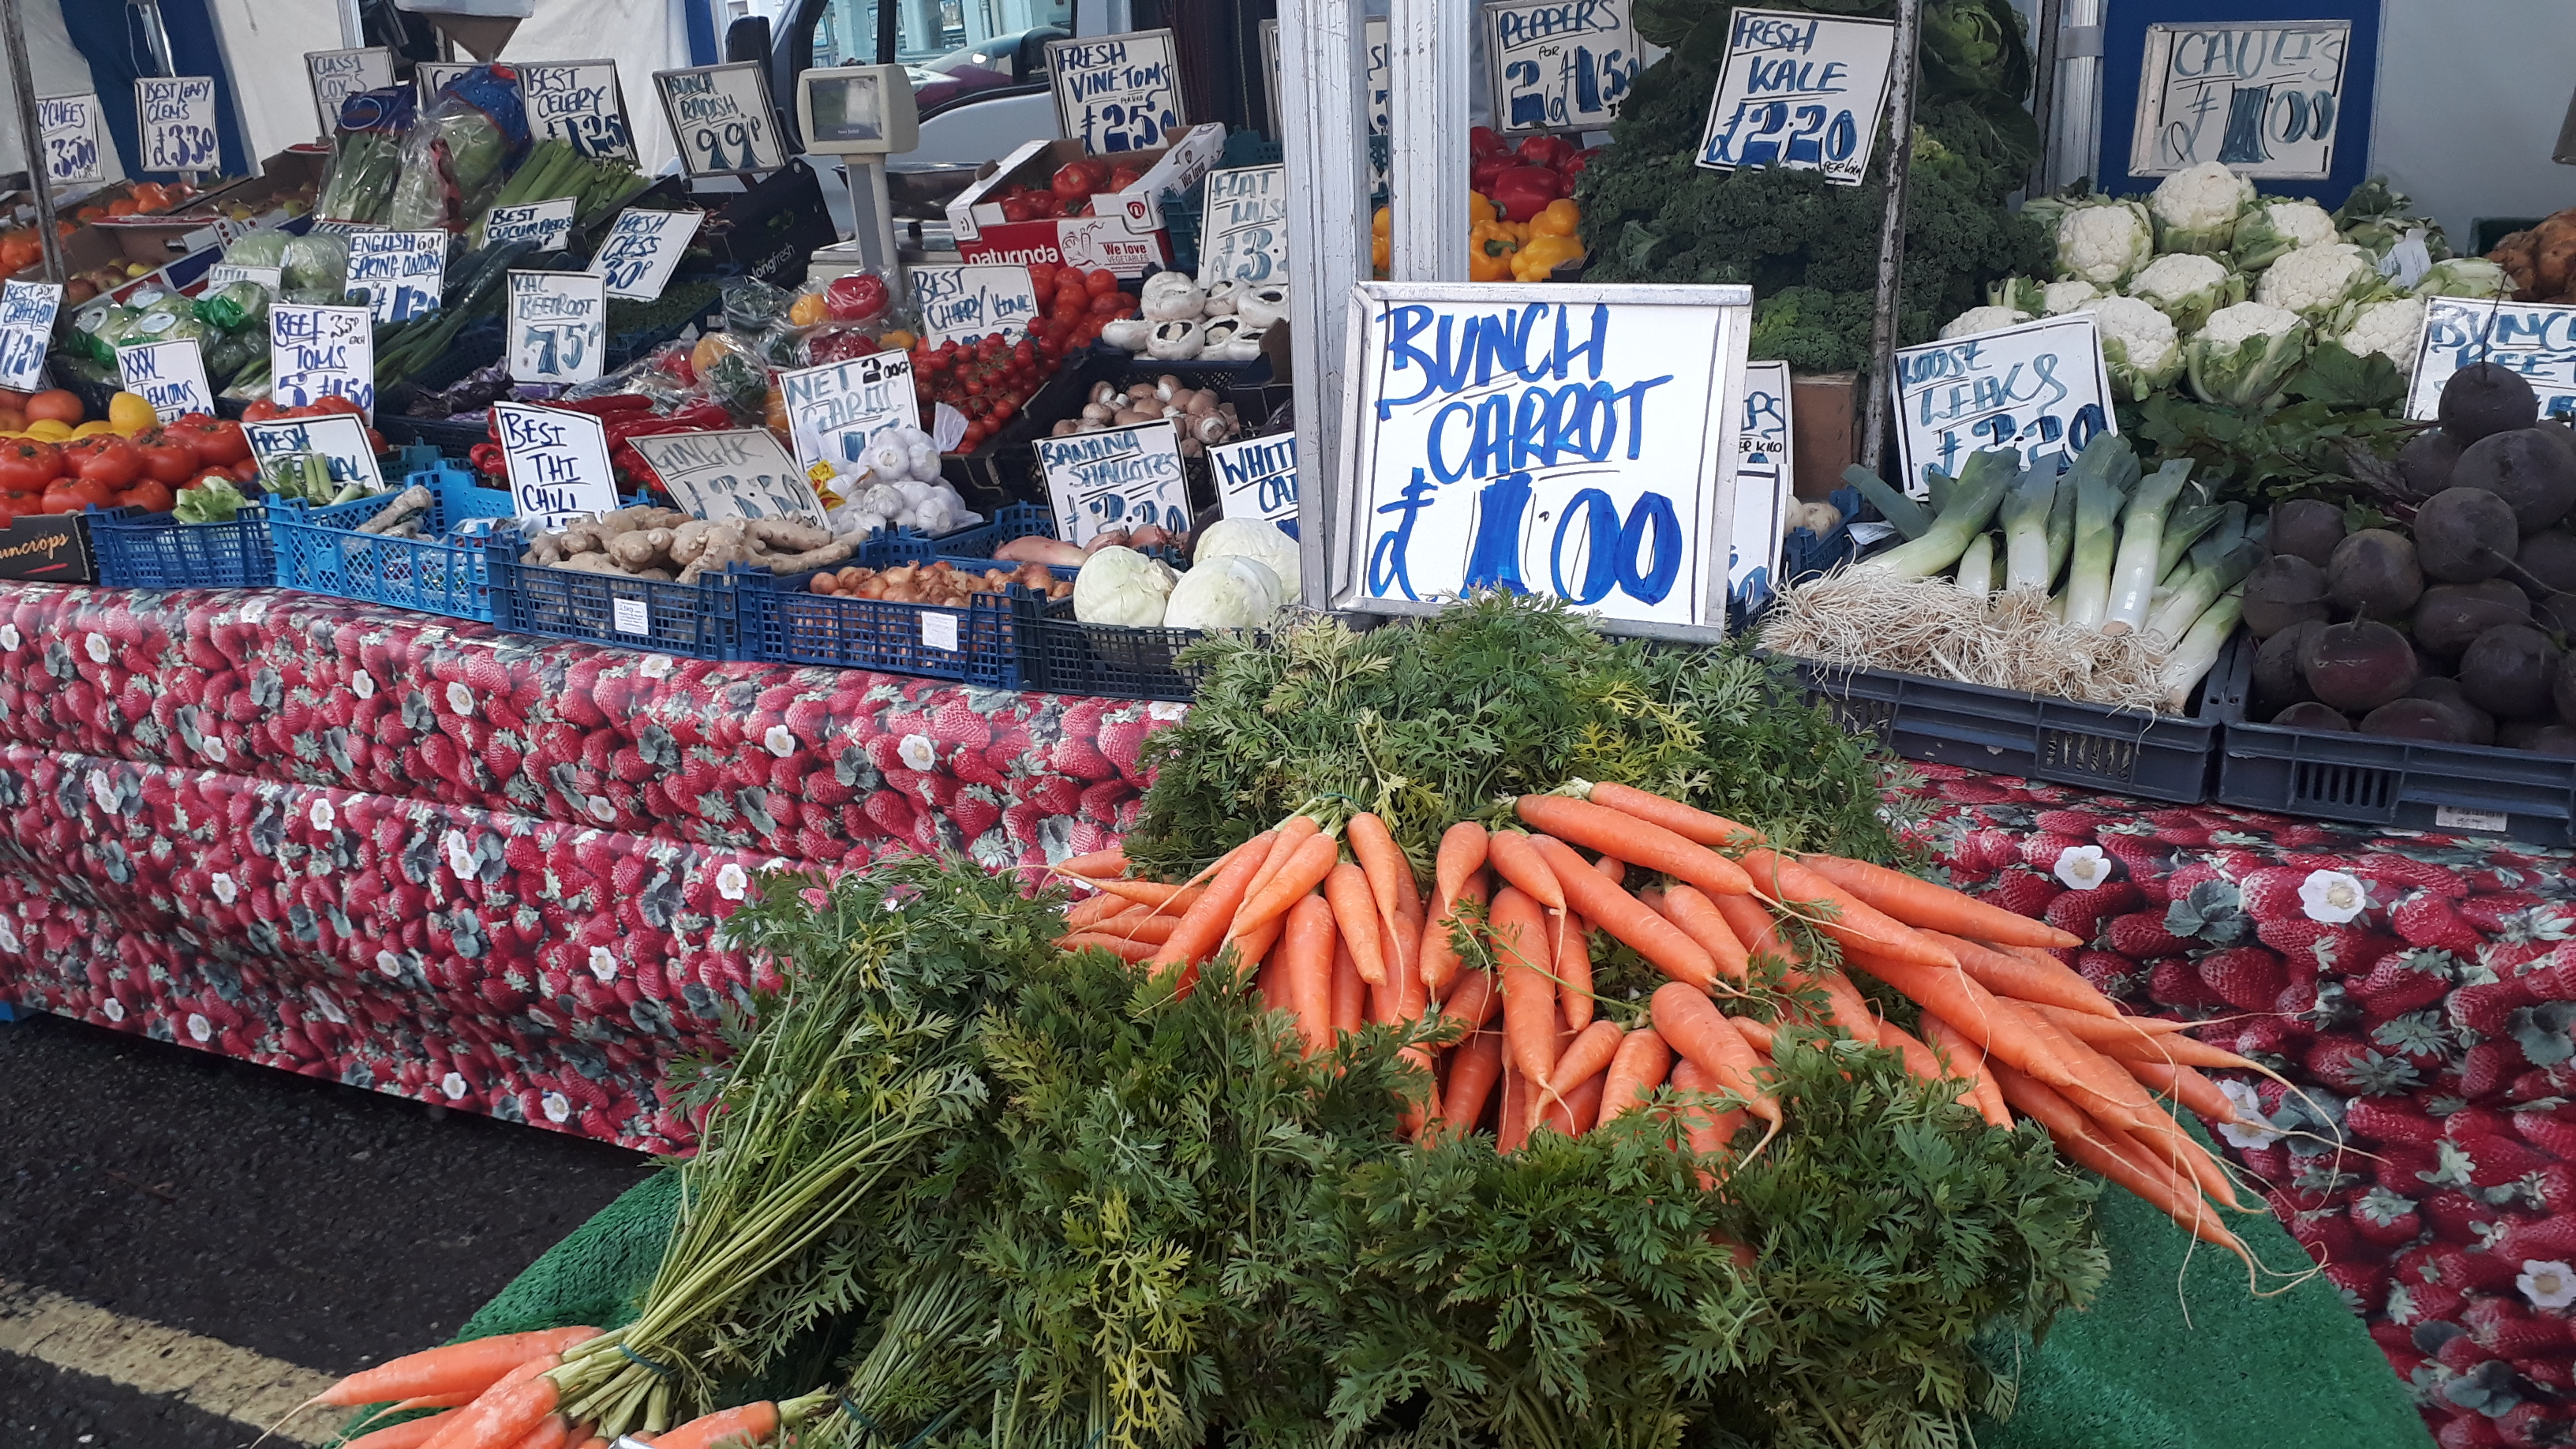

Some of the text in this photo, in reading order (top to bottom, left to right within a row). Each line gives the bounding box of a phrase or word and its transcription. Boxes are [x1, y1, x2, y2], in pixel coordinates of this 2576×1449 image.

[1733, 16, 1818, 55] FRESH
[1058, 42, 1127, 72] FRESH
[1539, 46, 1560, 60] FOR
[528, 68, 579, 94] BEST
[1069, 62, 1171, 103] VINE TOMS
[1748, 56, 1848, 94] KALE
[145, 83, 178, 103] BEST
[537, 86, 607, 118] CELERY
[1706, 102, 1857, 165] £2.20
[2161, 84, 2335, 164] £1.00
[1824, 161, 1845, 173] PER
[1213, 171, 1277, 200] FLAT
[490, 208, 538, 225] BEST
[350, 234, 416, 252] ENGLISH
[601, 235, 661, 261] CRESS
[1103, 243, 1147, 255] We love
[1107, 254, 1149, 264] VEGETABLES
[346, 254, 400, 280] SPRING
[750, 242, 795, 279] longfresh
[3, 284, 36, 302] BEST
[512, 275, 549, 293] VAC
[912, 267, 965, 313] BEST
[519, 293, 597, 320] BEETROOT
[273, 311, 326, 347] BEEF
[285, 339, 348, 371] TOMS
[1375, 302, 1609, 421] BUNCH
[1900, 340, 1993, 389] LOOSE
[788, 365, 850, 406] NET
[802, 380, 904, 433] GARLIC
[245, 423, 313, 456] FRESH
[502, 413, 567, 449] BEST
[1427, 374, 1674, 485] CARROT
[639, 435, 763, 467] GINGER
[1040, 430, 1145, 475] BANANA
[1756, 440, 1783, 453] KILO
[522, 484, 577, 519] CHILI
[1368, 467, 1681, 606] £1.00
